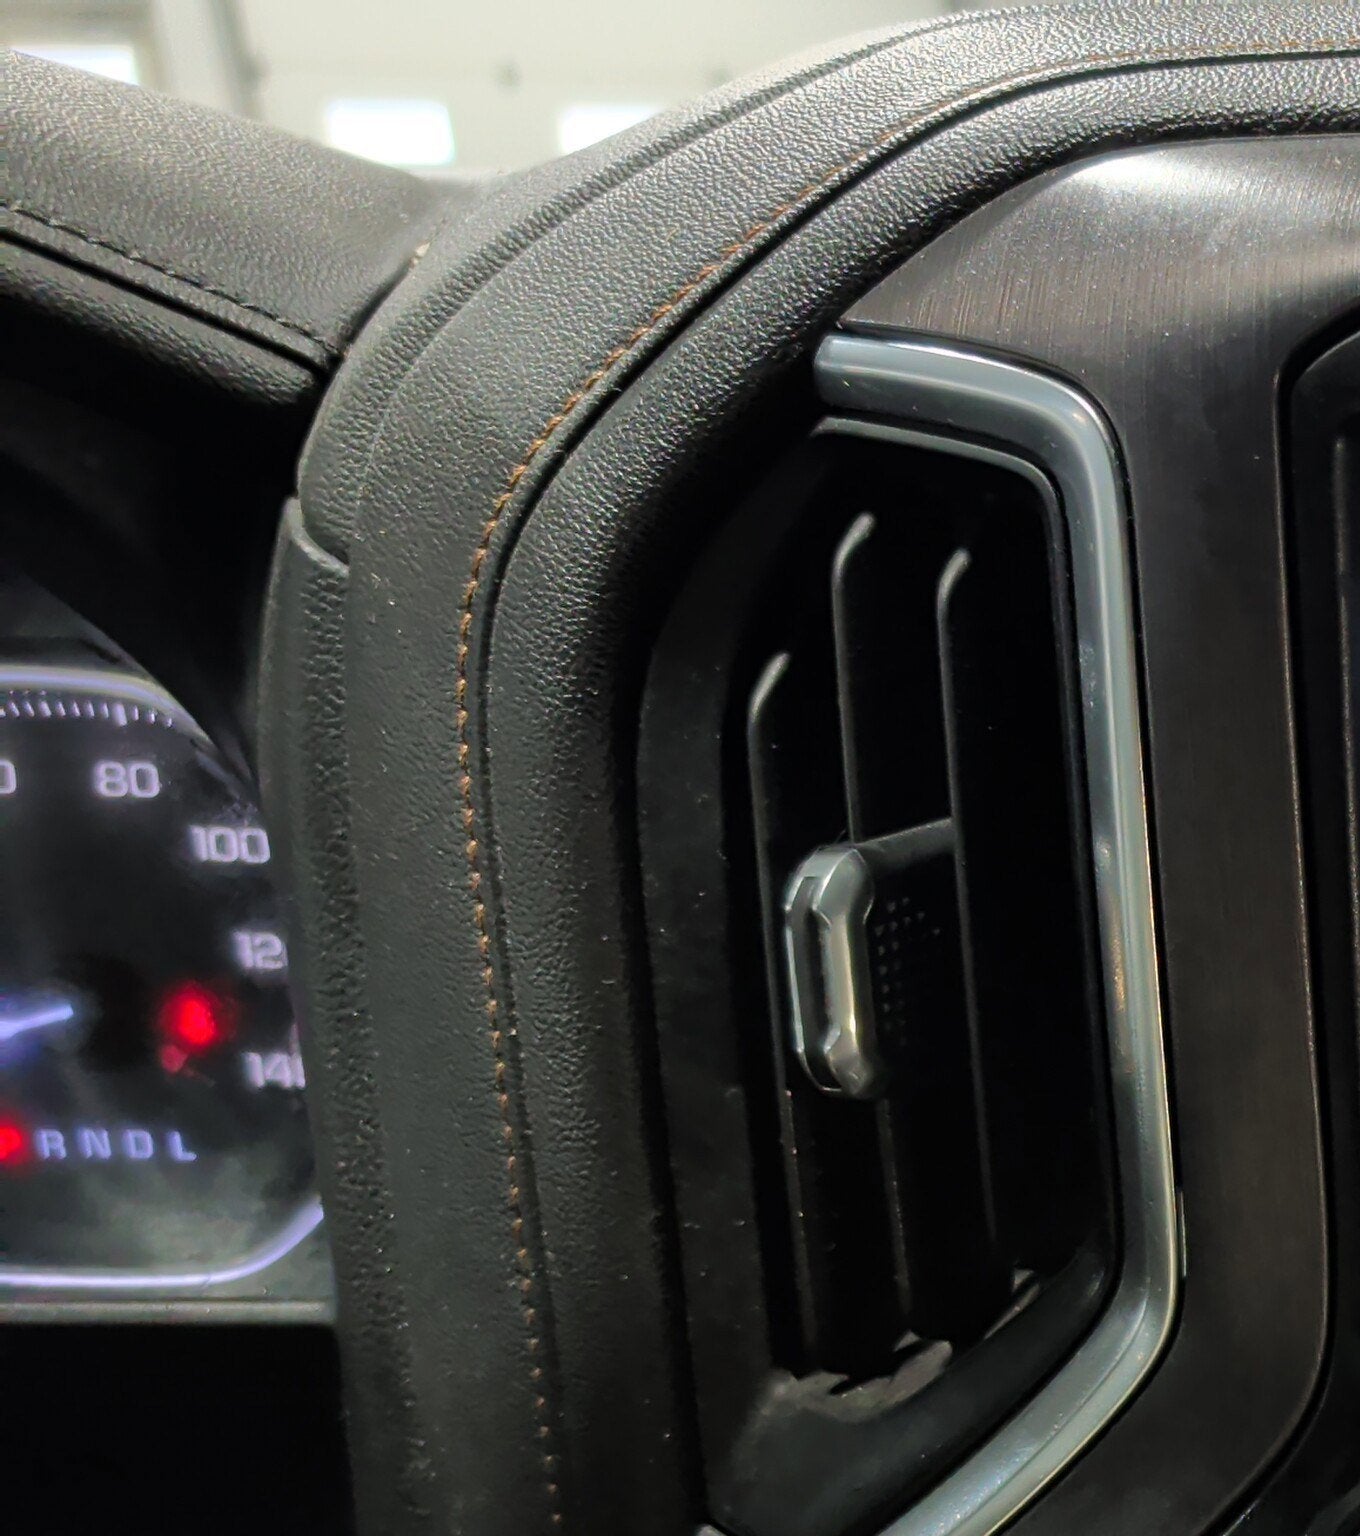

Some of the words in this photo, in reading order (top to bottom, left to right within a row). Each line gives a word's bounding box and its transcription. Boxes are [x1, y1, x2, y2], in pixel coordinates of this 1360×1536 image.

[94, 761, 161, 798] 80
[190, 825, 271, 864] 100
[37, 1128, 67, 1160] R
[79, 1128, 112, 1160] N
[123, 1128, 154, 1160] D
[167, 1130, 197, 1162] L
